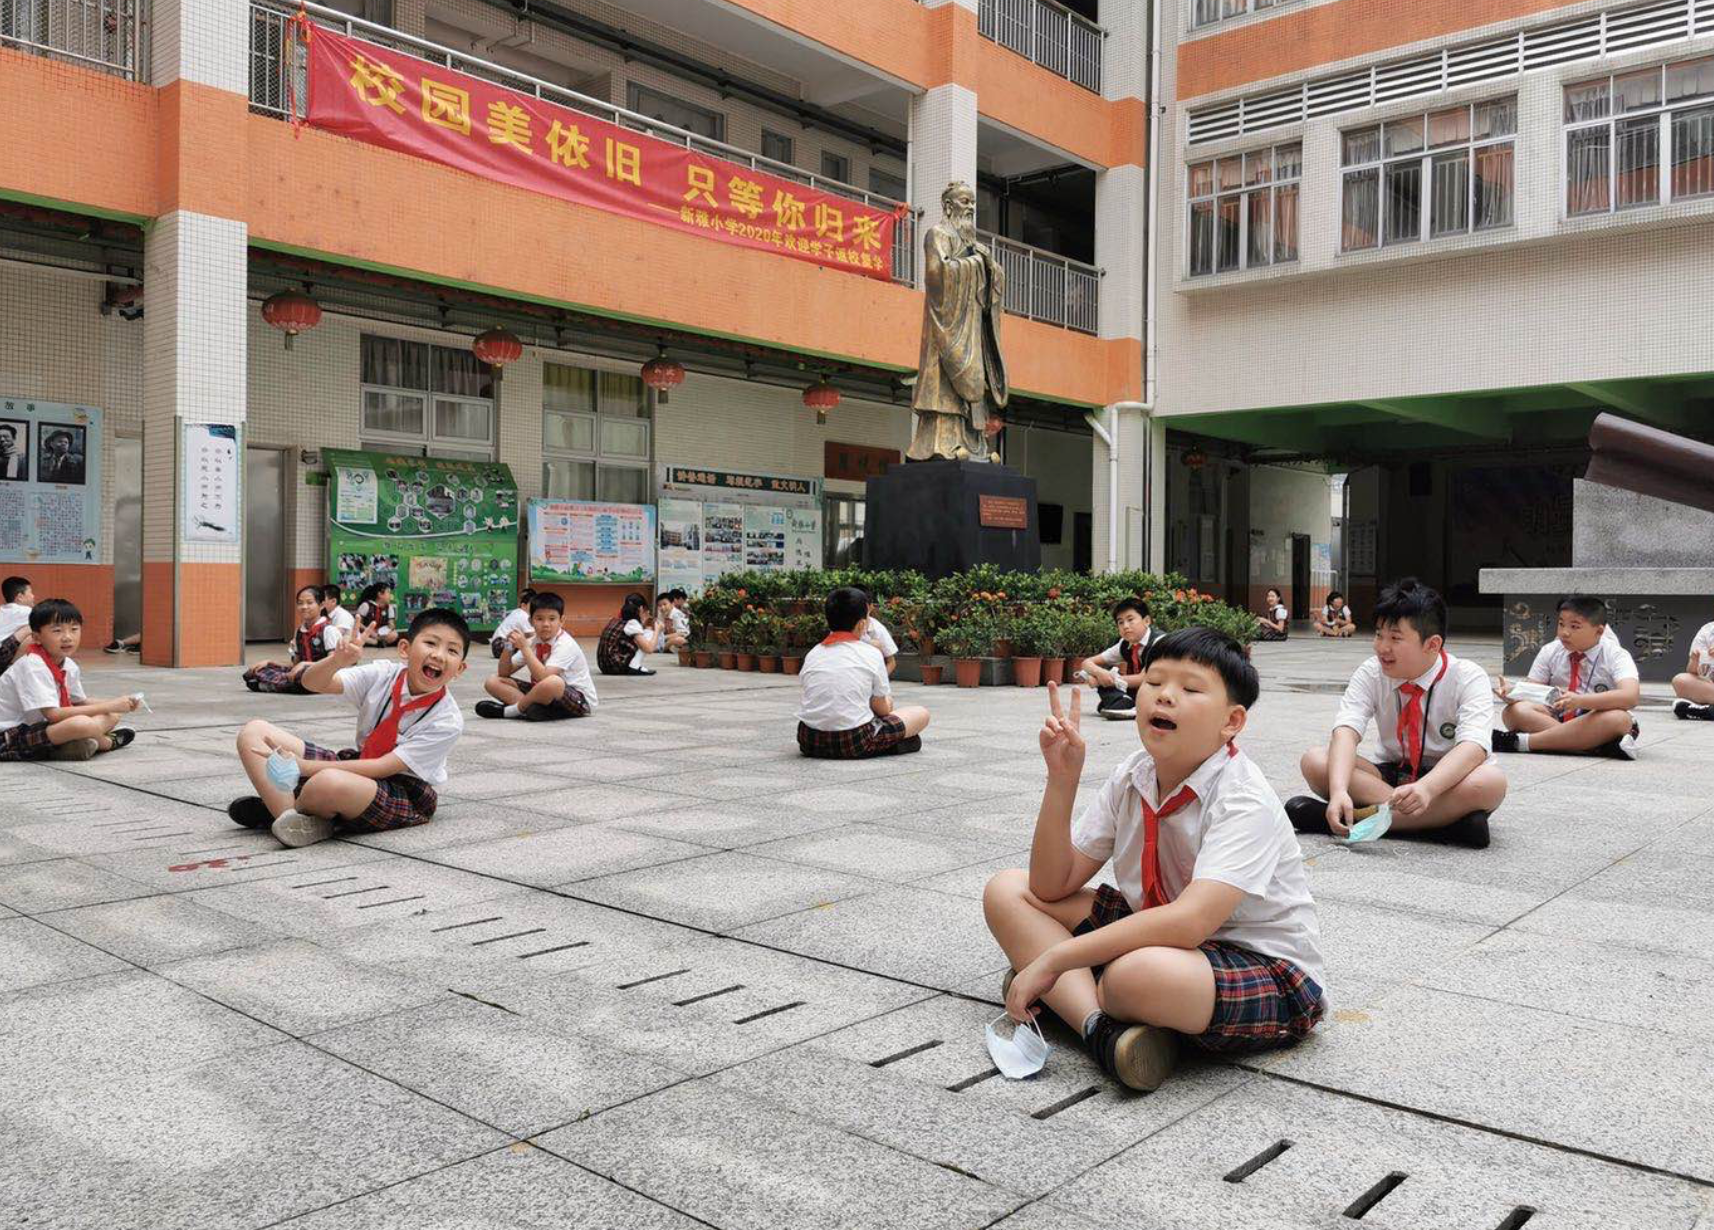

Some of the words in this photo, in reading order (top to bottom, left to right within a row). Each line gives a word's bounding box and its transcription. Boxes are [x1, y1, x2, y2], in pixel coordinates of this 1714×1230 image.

[349, 54, 642, 187] 校园美依旧
[682, 163, 882, 251] 只等你归来
